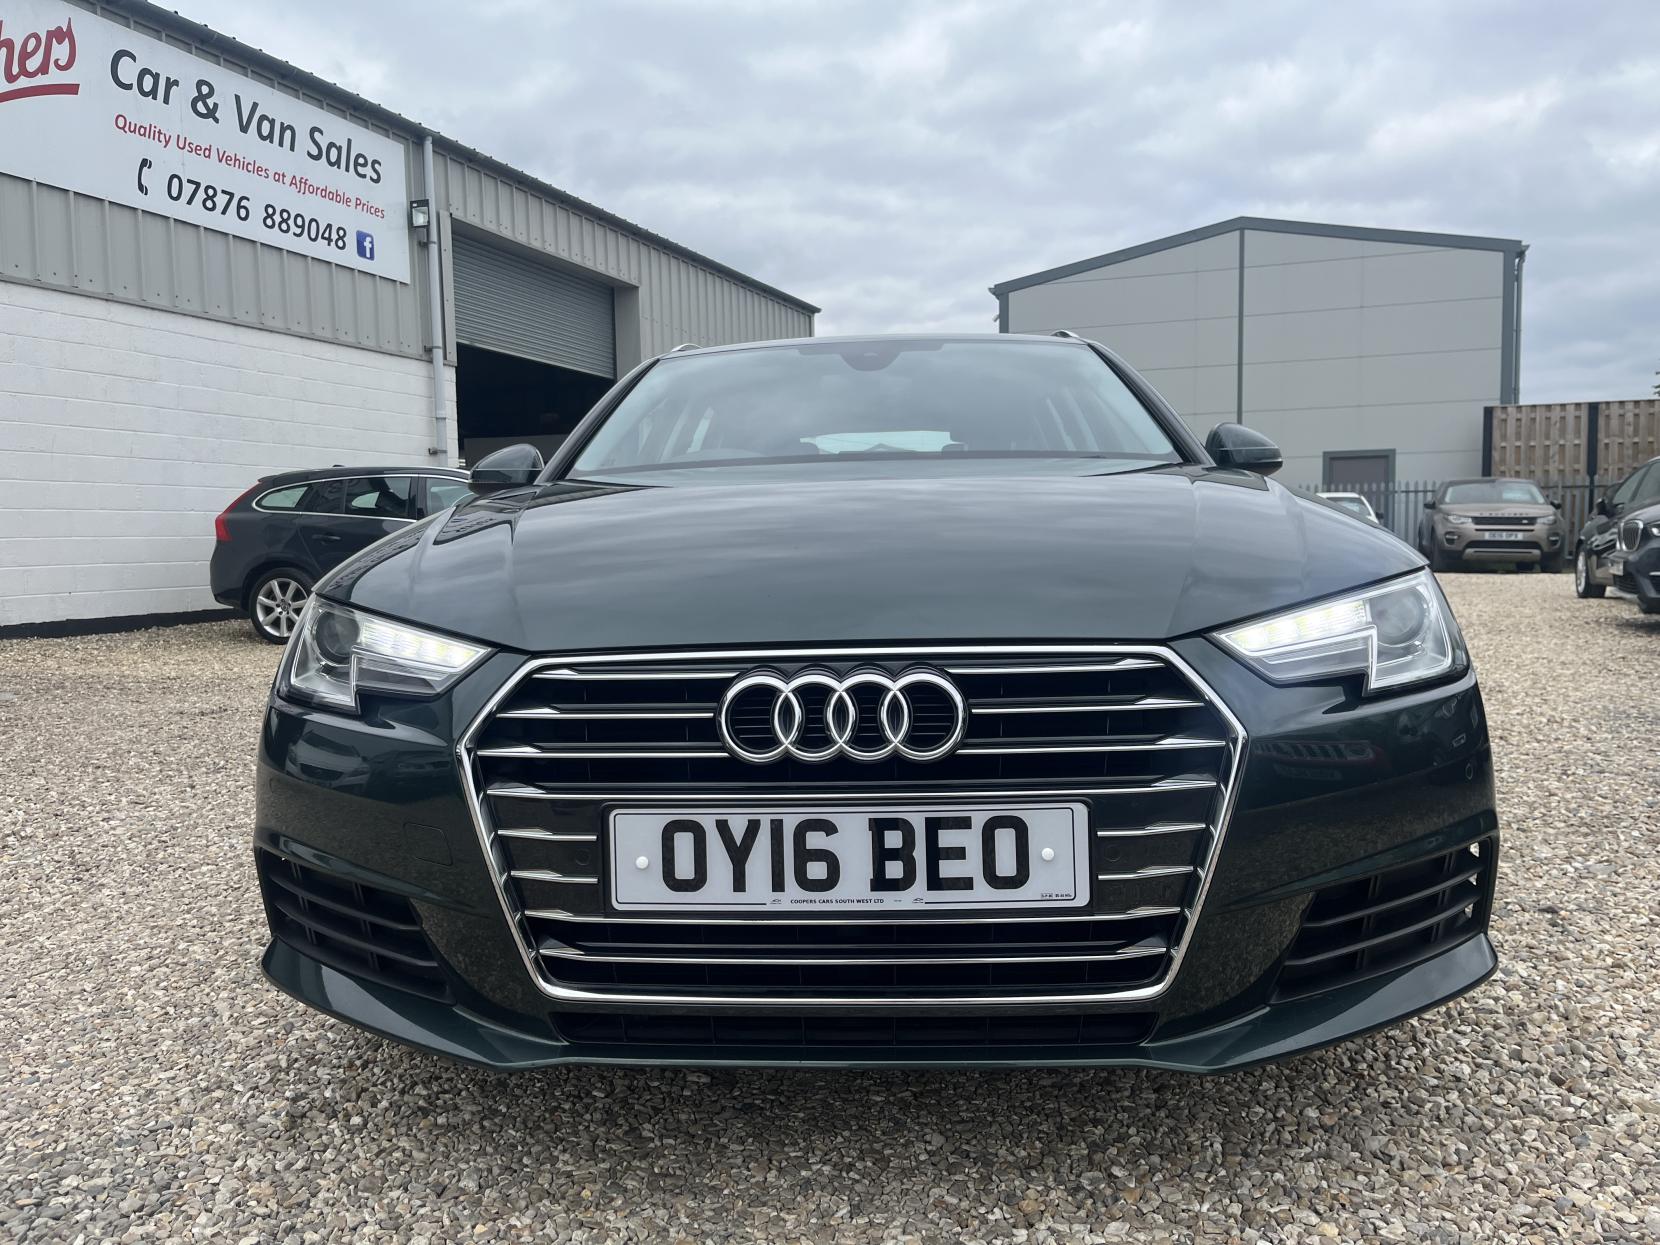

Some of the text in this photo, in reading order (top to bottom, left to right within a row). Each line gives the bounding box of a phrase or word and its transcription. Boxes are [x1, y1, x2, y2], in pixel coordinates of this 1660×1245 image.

[110, 48, 382, 184] Car & Van Sales
[114, 113, 385, 220] Quality Used Vehicles at Affordable Prices
[166, 173, 347, 251] 07876 889048
[661, 814, 1031, 893] OY16 BEO
